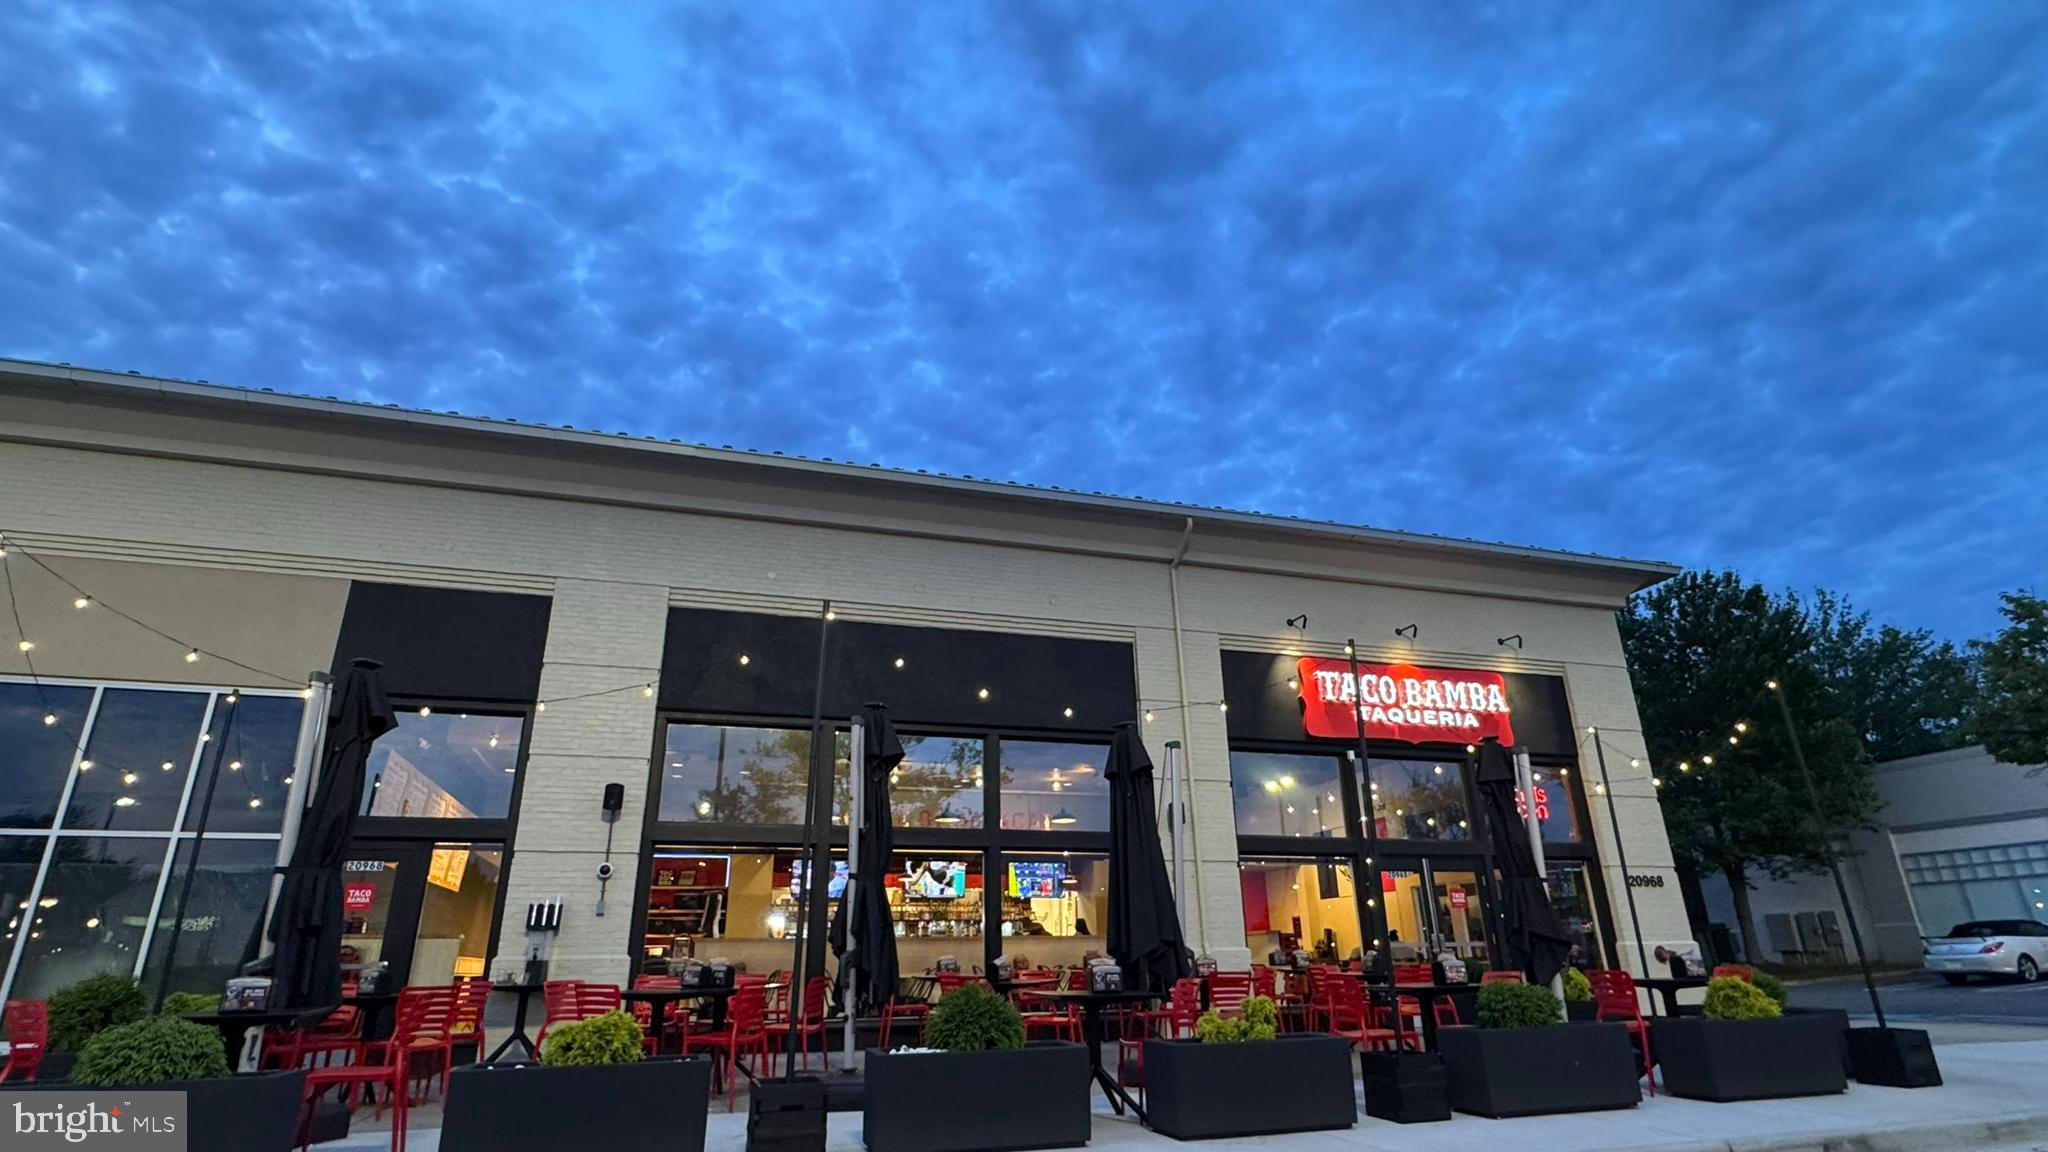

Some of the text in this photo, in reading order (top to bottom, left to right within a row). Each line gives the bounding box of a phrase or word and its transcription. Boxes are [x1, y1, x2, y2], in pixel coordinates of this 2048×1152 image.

[1314, 670, 1510, 713] TACO BAMBA
[1359, 705, 1480, 727] TAQUERIA
[348, 861, 383, 870] 20968
[1628, 875, 1664, 887] 20968
[348, 889, 372, 897] TACO
